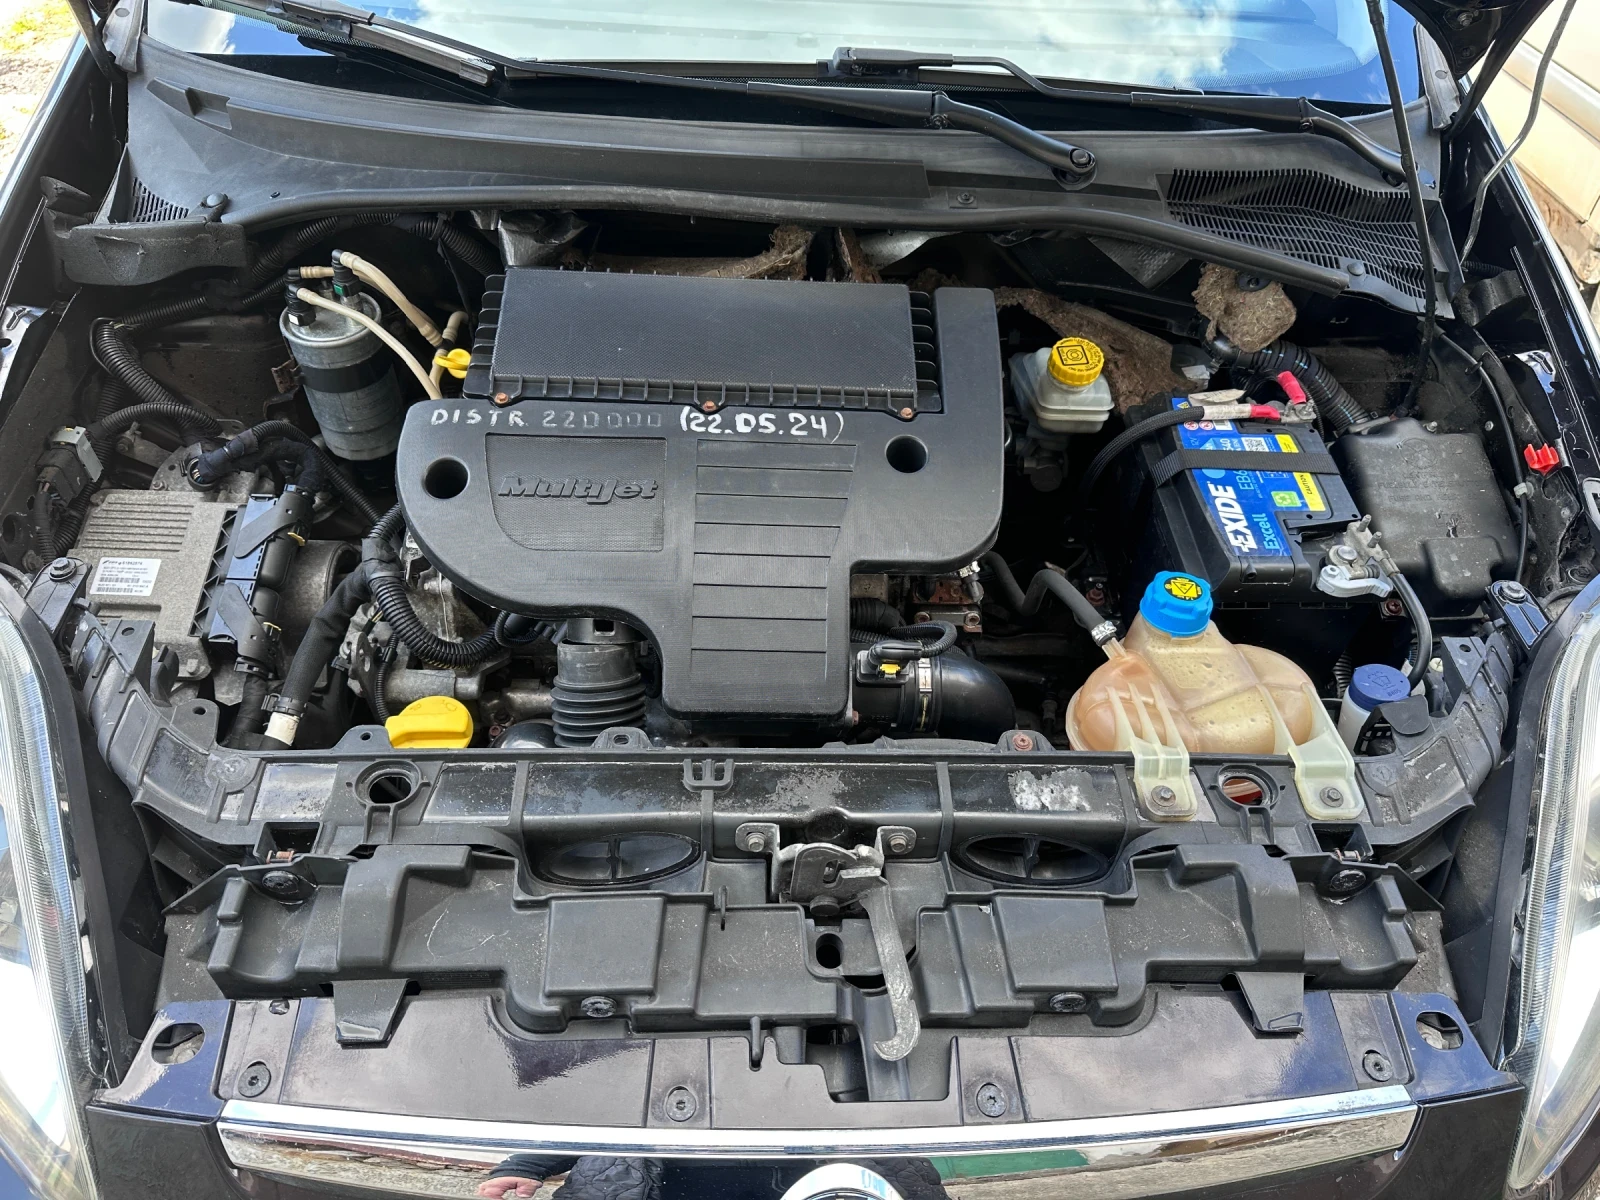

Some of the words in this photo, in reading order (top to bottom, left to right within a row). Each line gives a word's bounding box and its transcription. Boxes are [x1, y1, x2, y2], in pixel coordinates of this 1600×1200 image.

[1300, 474, 1313, 494] CAUTION
[1207, 483, 1258, 552] EXIDE
[1252, 512, 1280, 550] Excell
